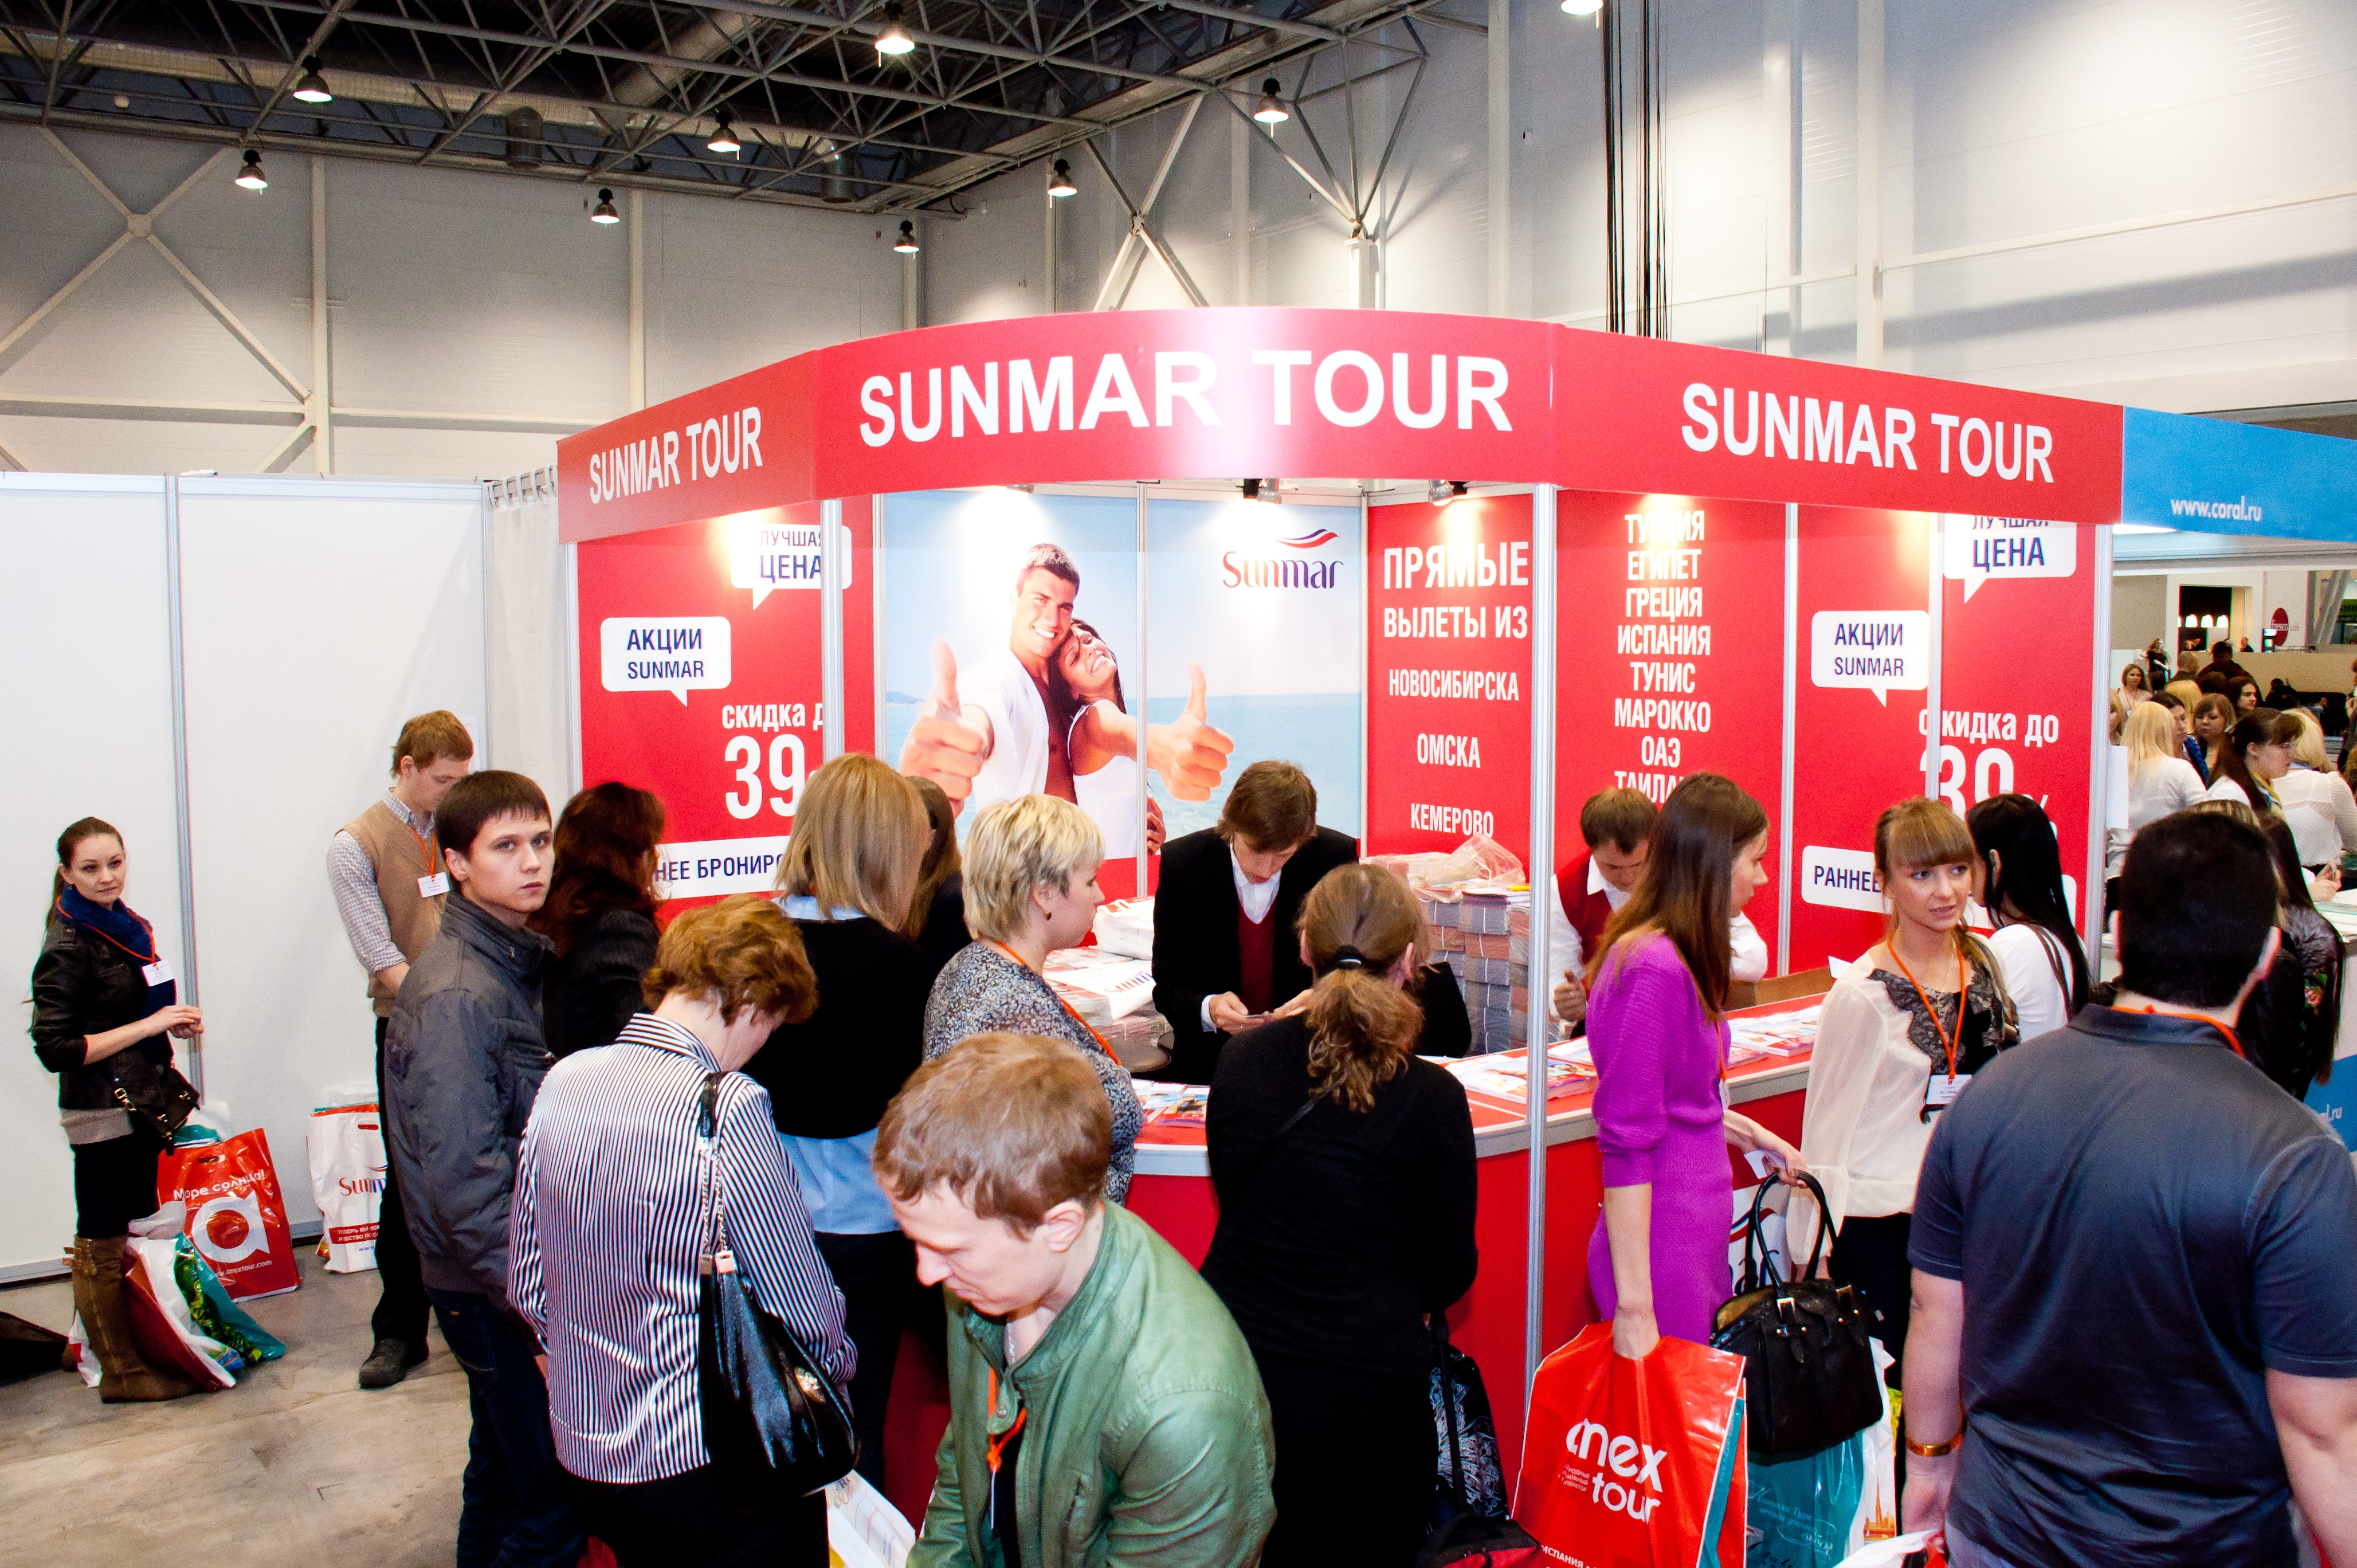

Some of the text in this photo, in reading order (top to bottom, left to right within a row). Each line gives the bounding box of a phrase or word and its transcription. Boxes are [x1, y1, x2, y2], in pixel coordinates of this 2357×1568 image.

[860, 349, 1513, 447] SUNMAR TOUR
[1682, 382, 2054, 483] SUNMAR TOUR
[590, 406, 763, 504] SUNMAR TOUR
[2170, 495, 2262, 522] www.coral.ru
[1625, 510, 1705, 547] ТУРЦИЯ
[760, 554, 822, 584] ЦЕНА
[1222, 551, 1344, 589] Sunmar
[1384, 541, 1529, 589] ПРЯМЫЕ
[1628, 548, 1702, 581] ЕГИПЕТ
[1973, 536, 2045, 573] ЦЕНА
[1626, 587, 1703, 622] ГРЕЦИЯ
[1384, 605, 1528, 640] ВЫЛЕТЫ ИЗ
[1834, 623, 1903, 650] АКЦИИ
[627, 628, 703, 654] АКЦИИ
[1617, 625, 1711, 656] ИСПАНИЯ
[627, 660, 704, 679] SUNMAR
[1630, 662, 1696, 693] ТУНИС
[1834, 657, 1904, 677] SUNMAR
[1389, 669, 1519, 701] НОВОСИБИРСКА
[722, 703, 806, 732] скидка
[1614, 698, 1711, 732] МАРОККО
[2024, 714, 2059, 748] до
[1417, 733, 1481, 769] ОМСКА
[1641, 735, 1681, 768] ОАЭ
[1614, 771, 1684, 803] ТАИЛА
[1410, 803, 1494, 838] КЕМЕРОВО
[1813, 865, 1882, 893] РАННЕЕ
[173, 1187, 209, 1201] Море
[1592, 1472, 1661, 1524] tour
[1541, 1545, 1584, 1568] ИСПАНИЯ
